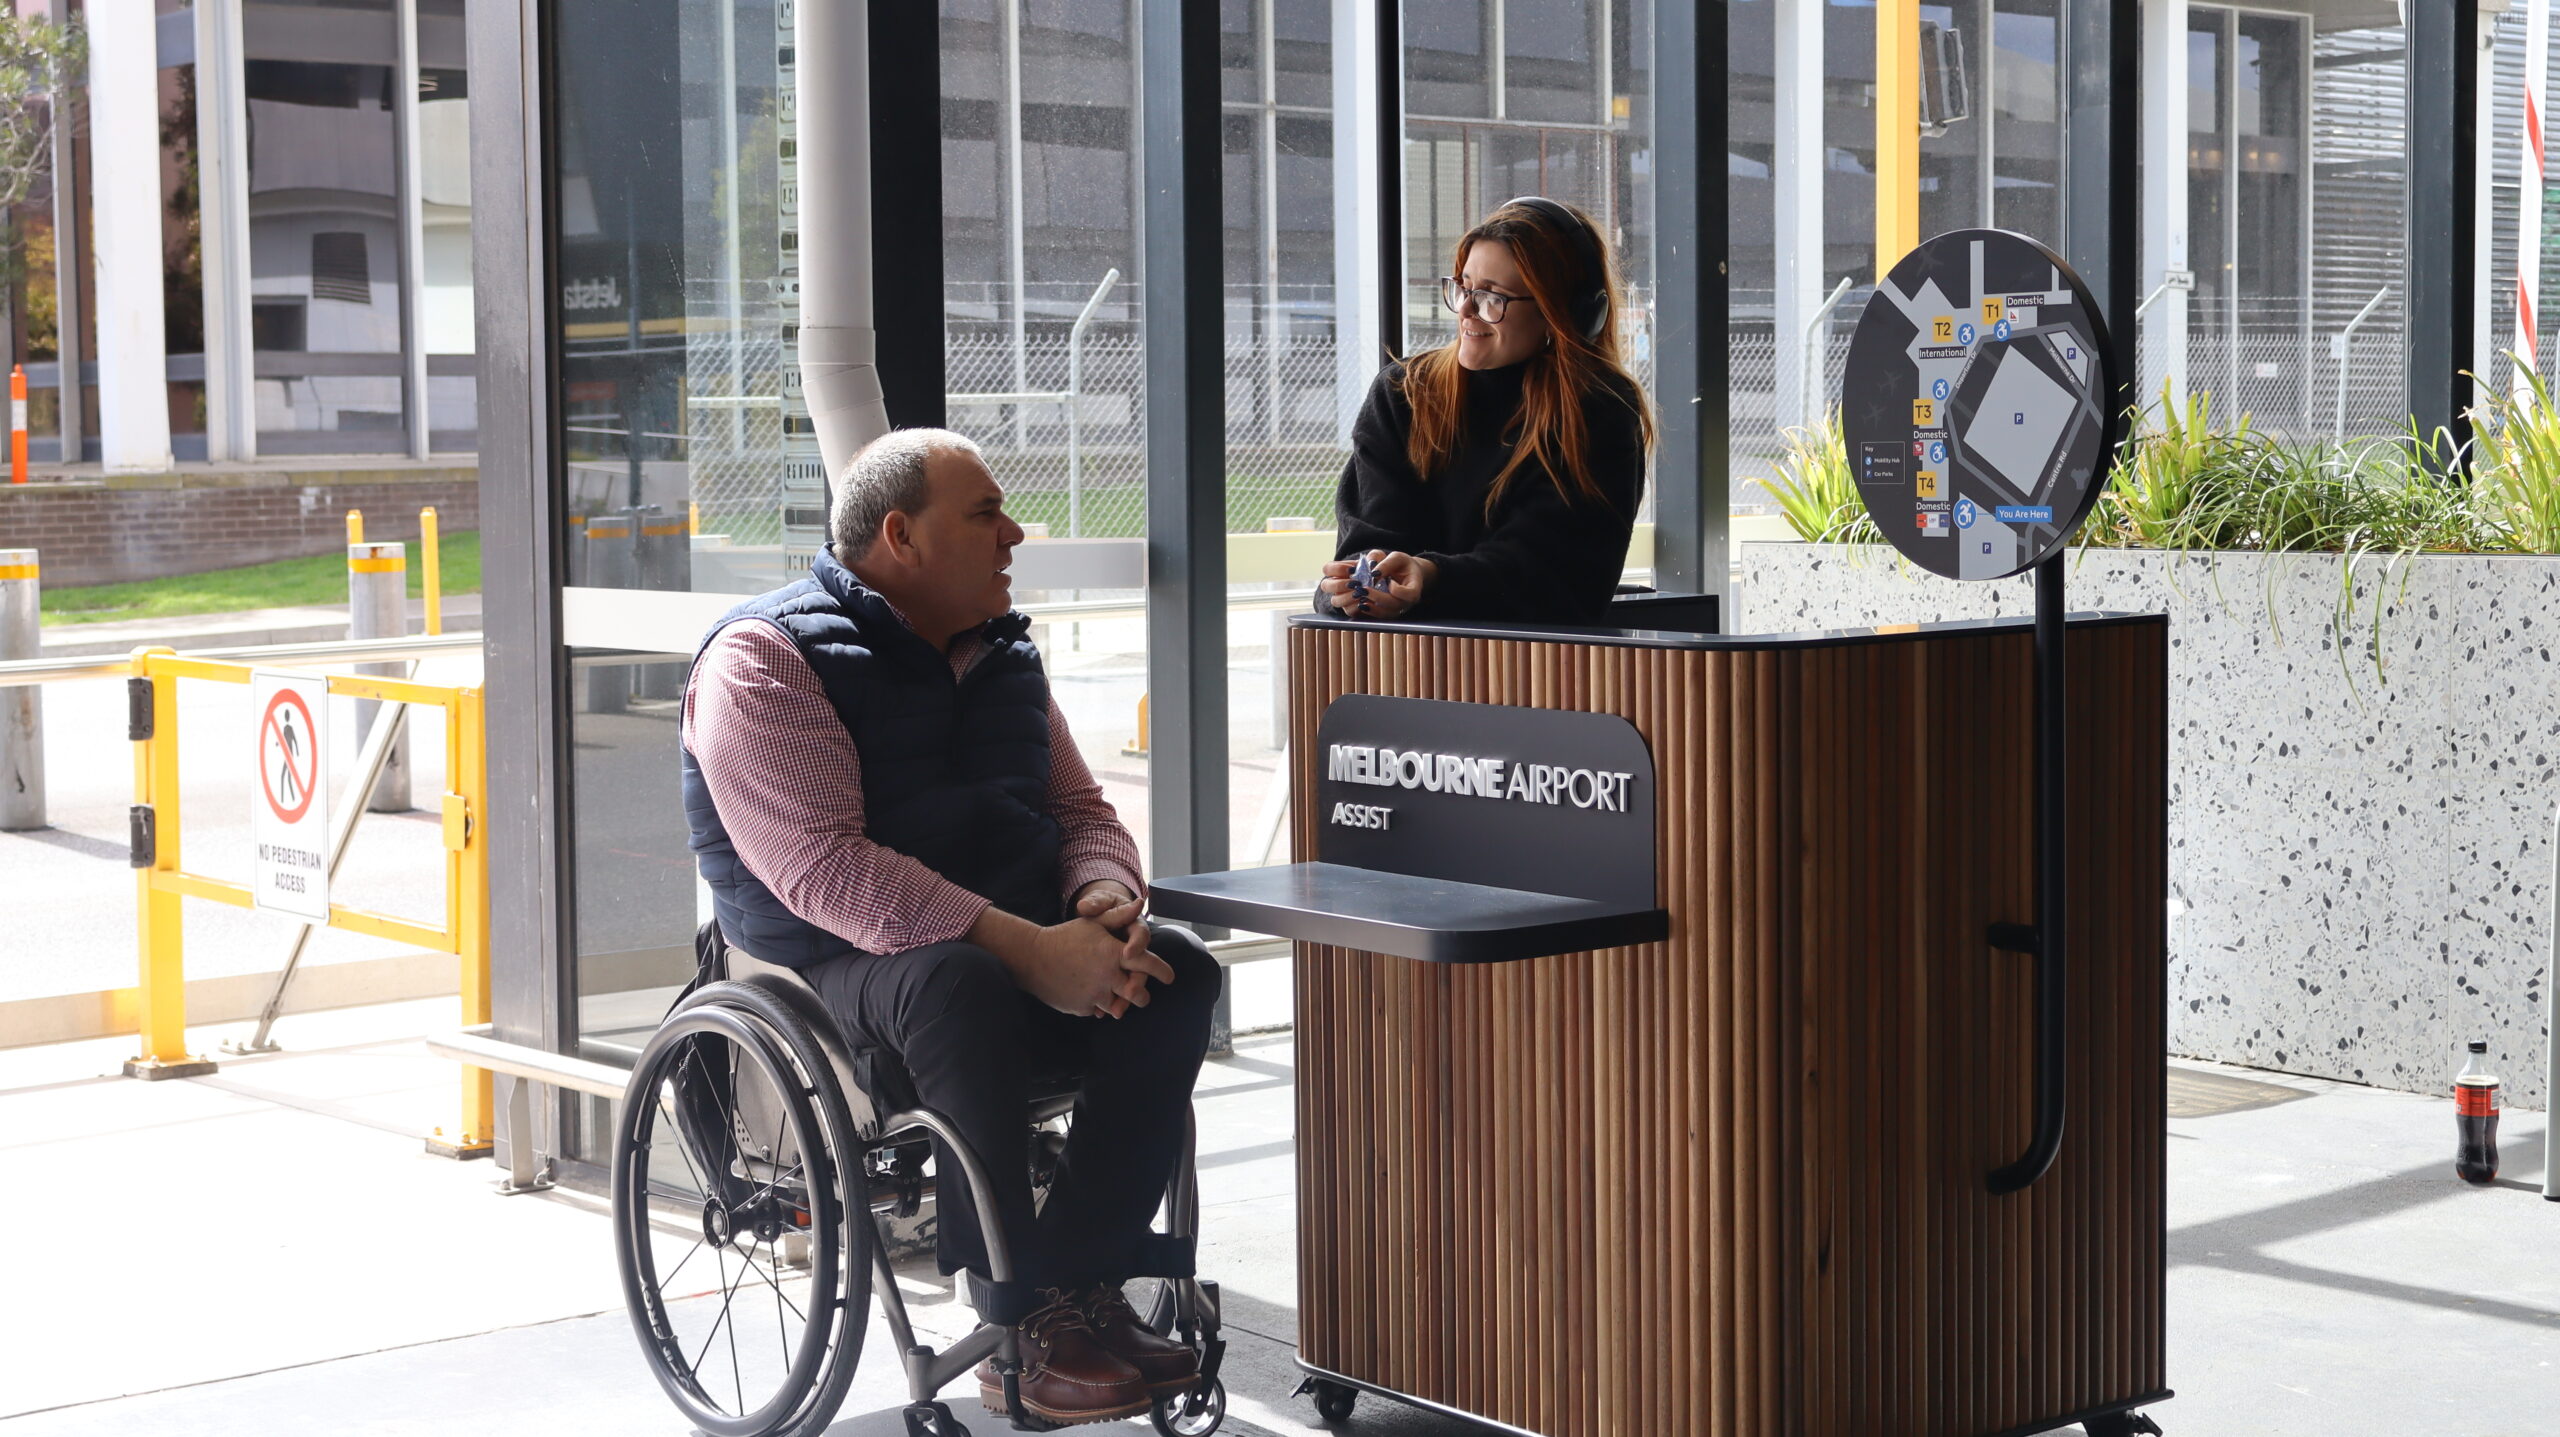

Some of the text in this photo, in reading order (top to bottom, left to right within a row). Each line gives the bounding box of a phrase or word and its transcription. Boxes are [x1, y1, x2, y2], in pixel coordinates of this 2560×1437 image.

[2007, 295, 2044, 306] Domestic
[1984, 303, 2000, 318] T1
[1934, 321, 1951, 337] T2
[1919, 346, 1967, 358] International
[1914, 404, 1932, 419] T3
[1913, 429, 1948, 439] Domestic
[2048, 450, 2068, 488] Centre Rd
[1918, 477, 1935, 491] T4
[1916, 501, 1951, 511] Domestic
[1999, 509, 2049, 519] You Are Here
[1328, 744, 1636, 813] MELBOURNE AIRPORT
[1331, 801, 1394, 830] ASSIST
[259, 843, 321, 871] NO PEDESTRIAN
[275, 872, 306, 894] ACCESS
